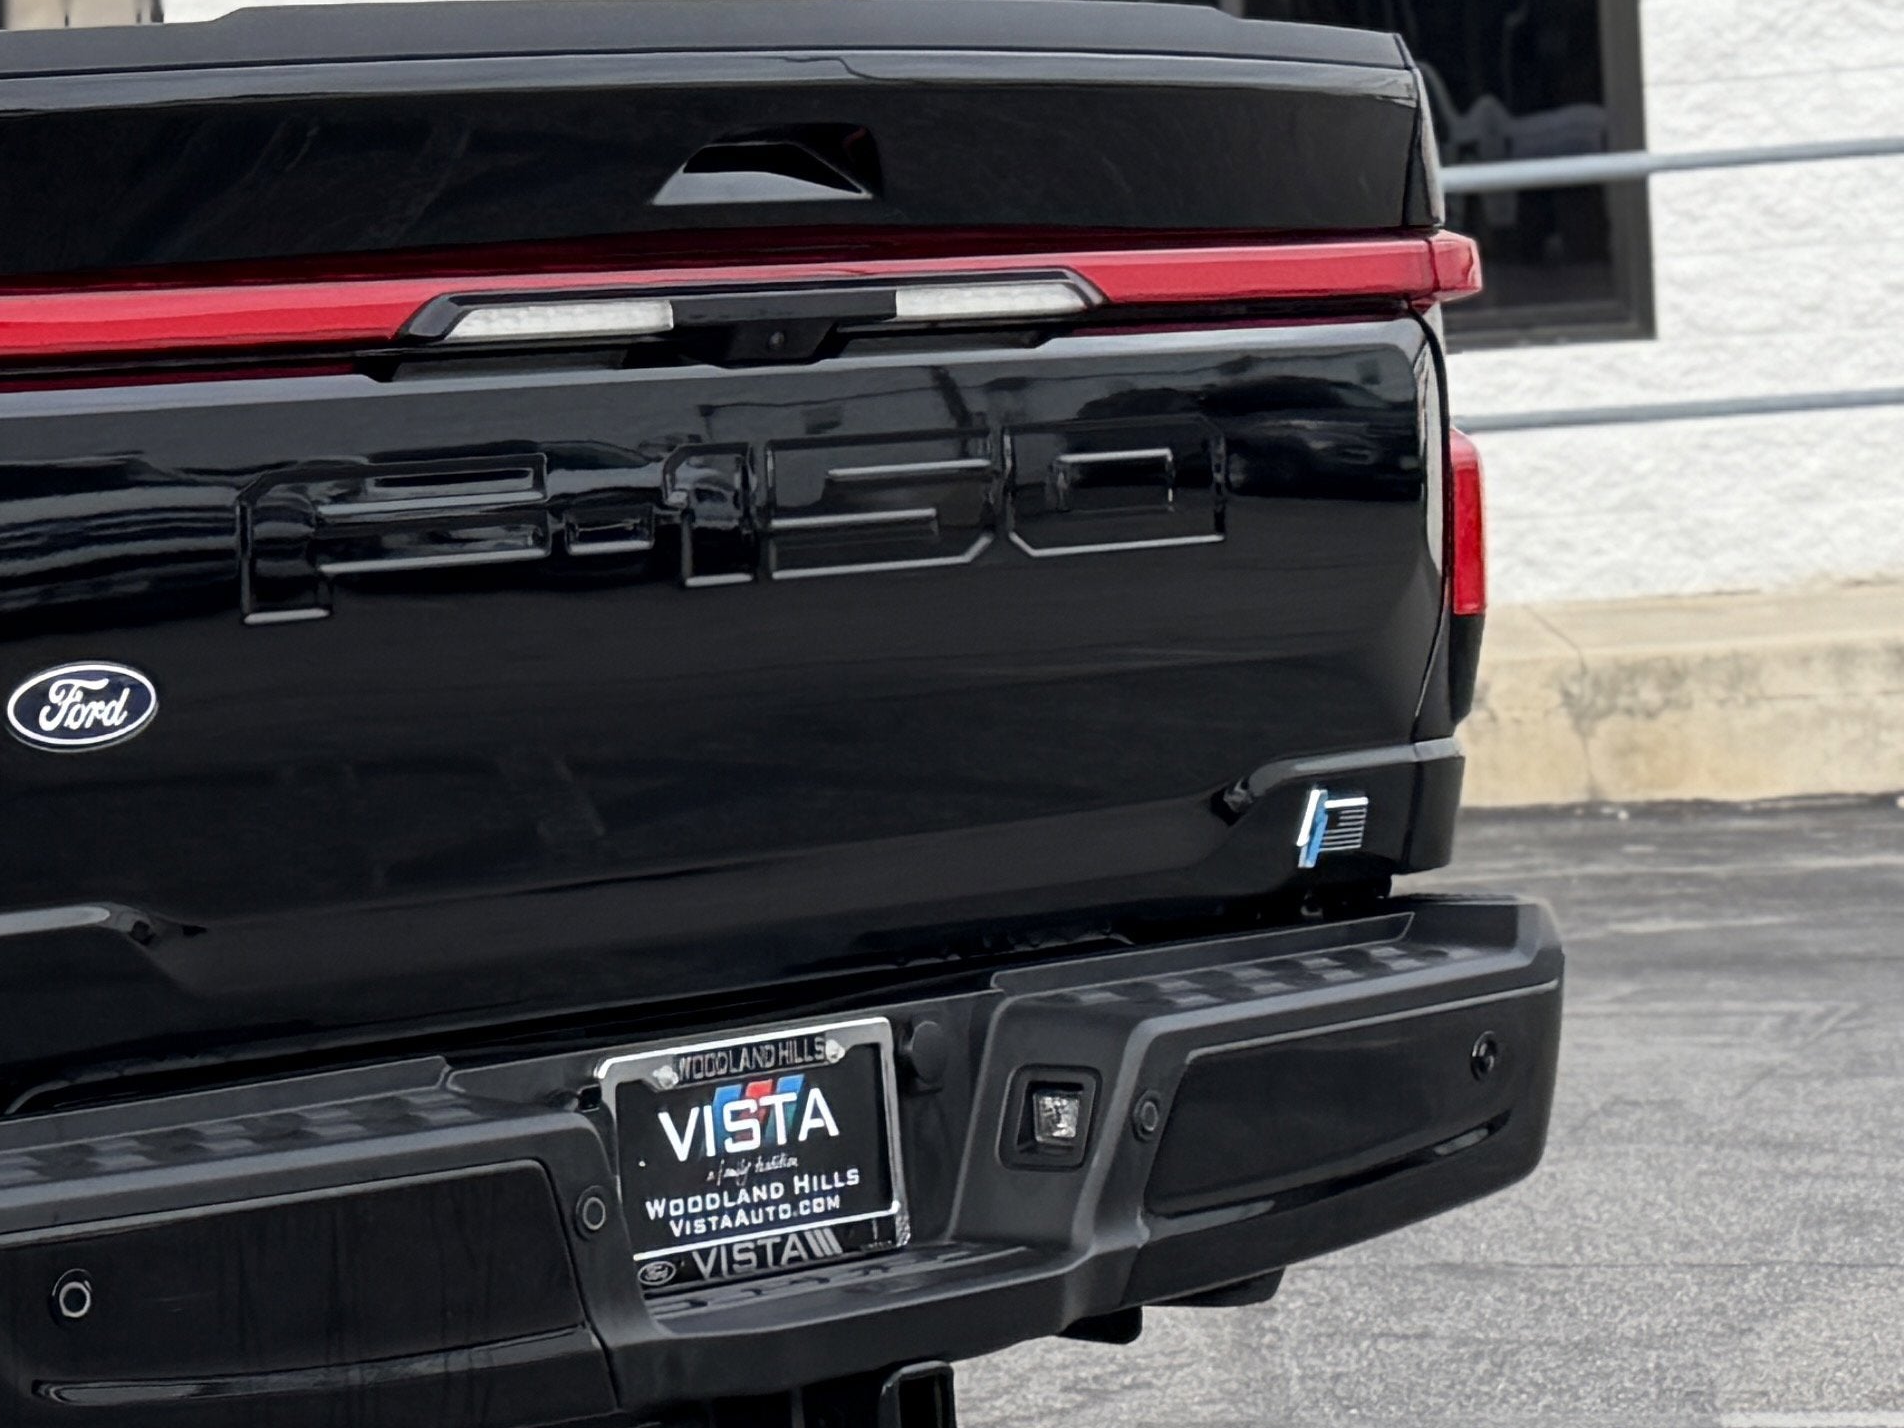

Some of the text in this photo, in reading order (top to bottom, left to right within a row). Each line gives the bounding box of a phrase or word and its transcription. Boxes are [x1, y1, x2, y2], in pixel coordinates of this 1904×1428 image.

[38, 678, 131, 732] Ford
[679, 1036, 825, 1080] WOODLAND HILLS
[658, 1087, 840, 1162] VISTA
[645, 1168, 861, 1221] WOODLAND HILLS
[692, 1228, 810, 1280] VISTA
